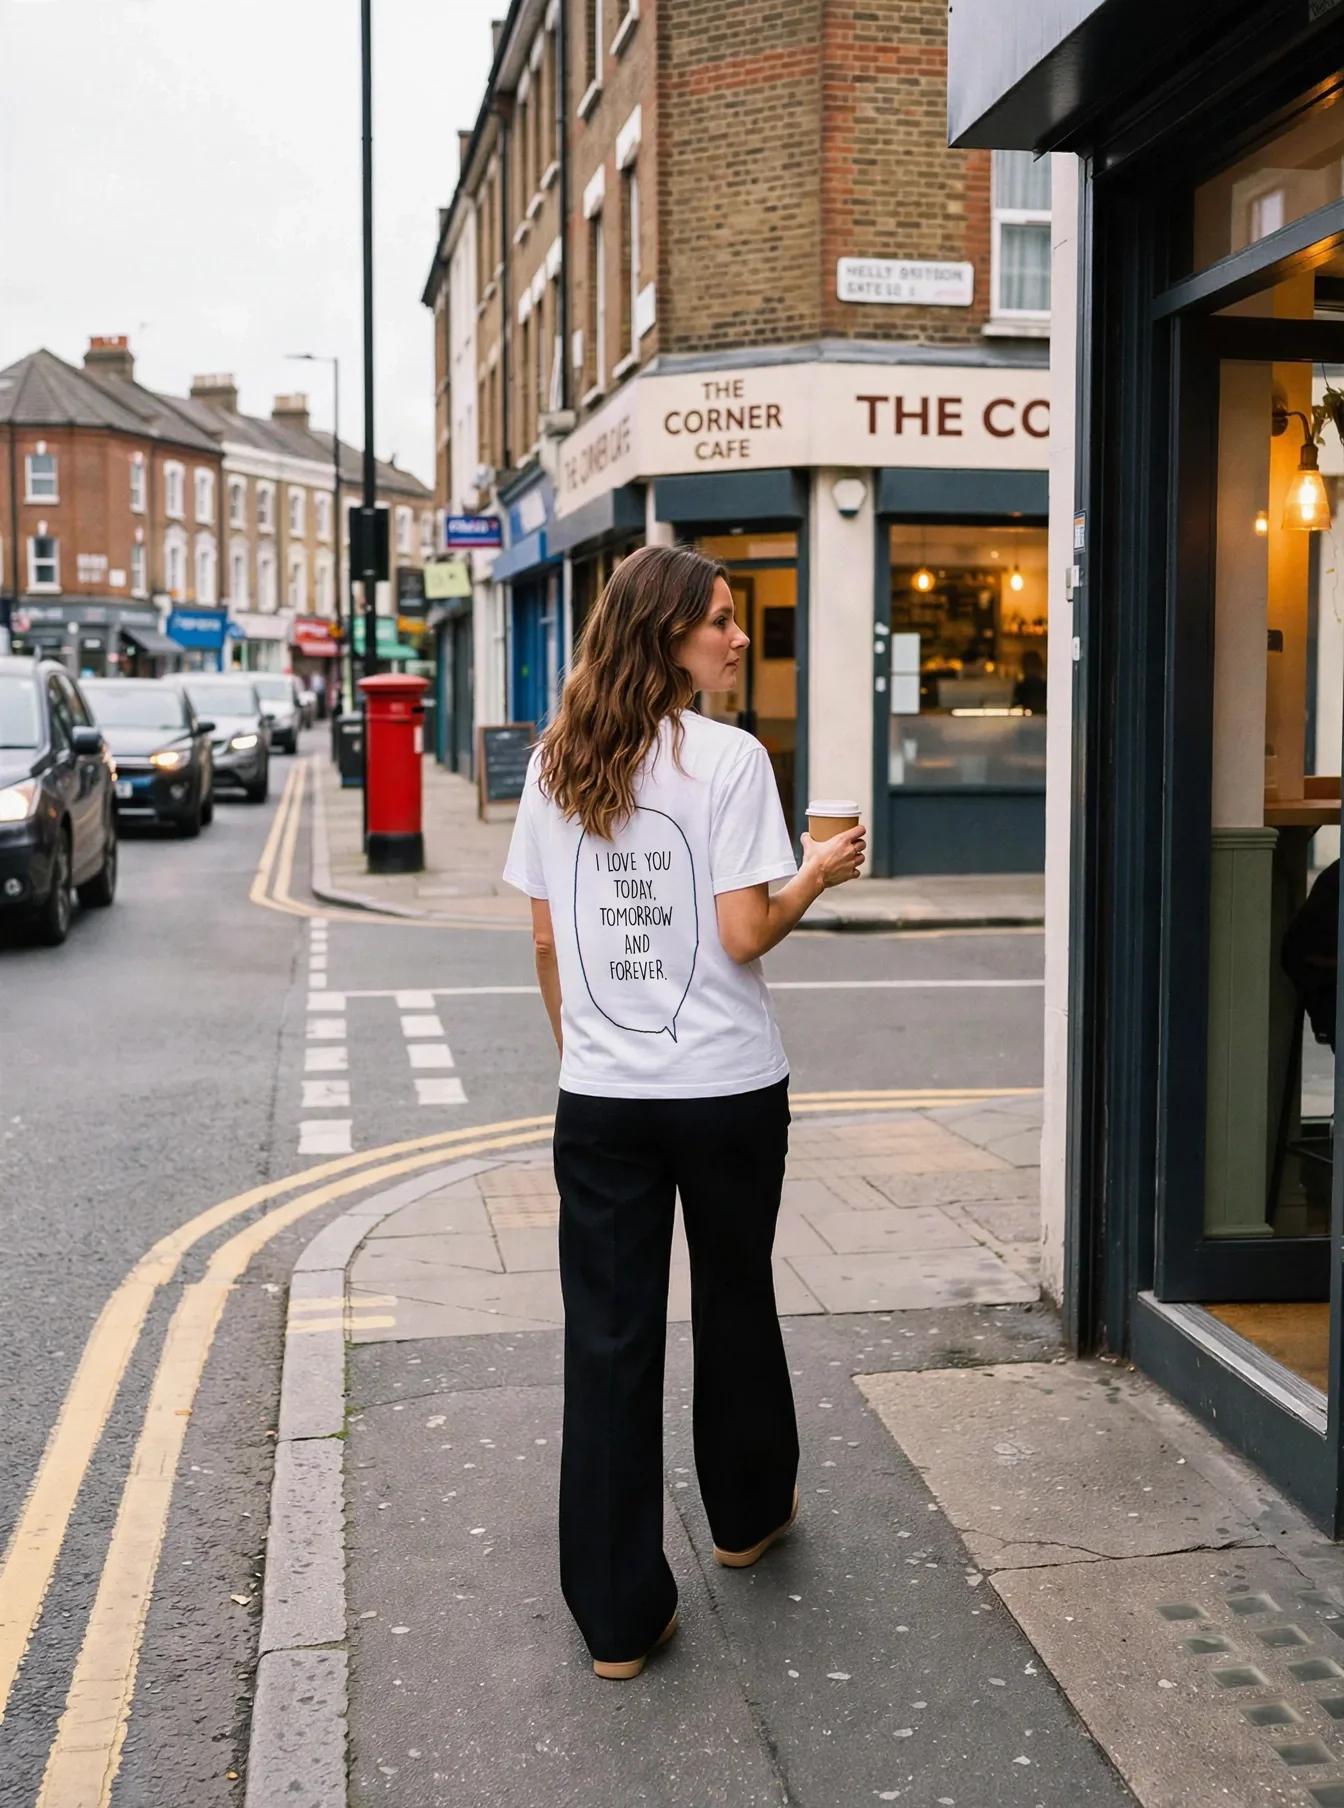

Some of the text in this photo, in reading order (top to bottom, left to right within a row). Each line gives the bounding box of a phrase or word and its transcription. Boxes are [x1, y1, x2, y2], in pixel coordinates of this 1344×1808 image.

[703, 379, 744, 400] THE
[664, 404, 782, 435] CORNER
[856, 395, 962, 436] THE
[695, 439, 751, 460] CAFE
[595, 851, 671, 872] I LOVE YOU
[599, 906, 673, 926] TOMORROW
[625, 934, 650, 954] AND
[609, 959, 668, 980] FOREVER.
